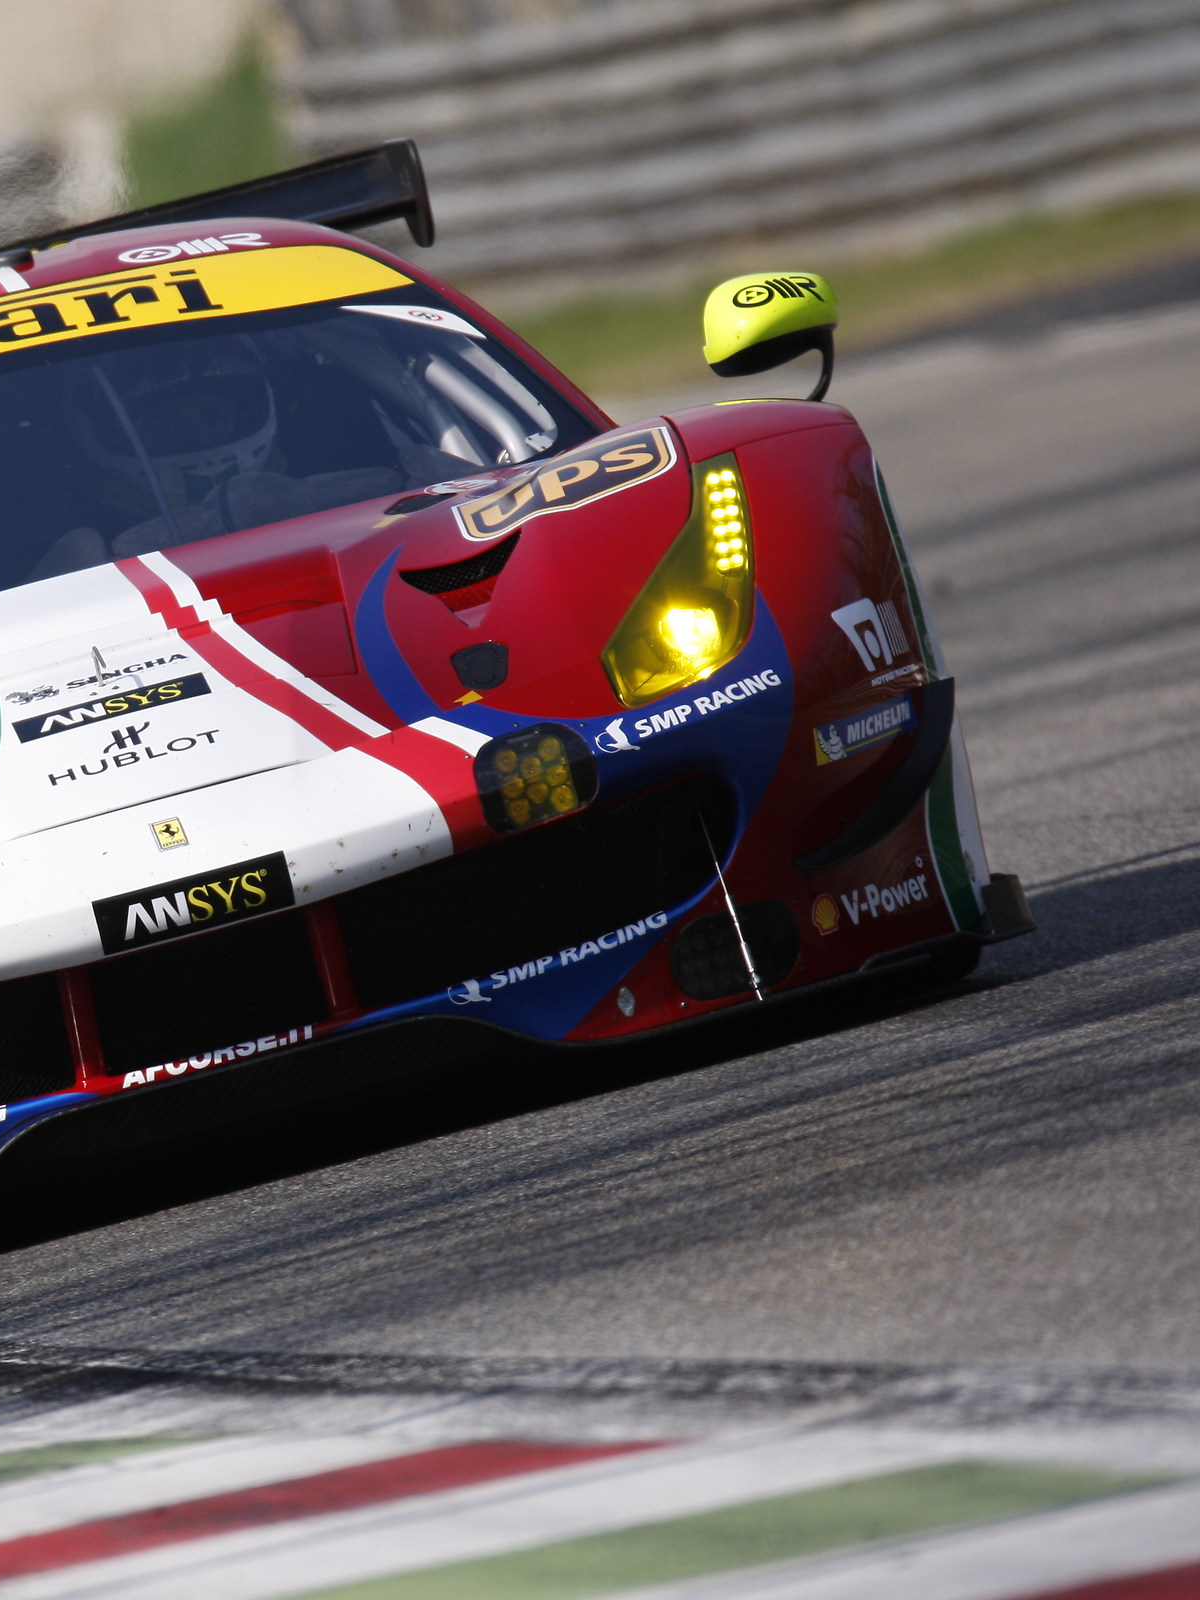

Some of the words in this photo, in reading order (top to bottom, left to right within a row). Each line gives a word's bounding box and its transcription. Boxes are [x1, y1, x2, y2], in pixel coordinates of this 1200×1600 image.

[480, 441, 655, 527] UPS
[66, 653, 189, 690] SINGHA
[40, 683, 183, 733] ANSYS
[635, 704, 693, 738] SMP
[693, 669, 782, 716] RACING
[846, 701, 911, 743] MICHELIN
[48, 728, 220, 786] HUBLOT
[123, 868, 268, 941] ANSYS
[841, 873, 929, 926] V-Power
[490, 956, 553, 988] SMP
[561, 911, 667, 966] RACING
